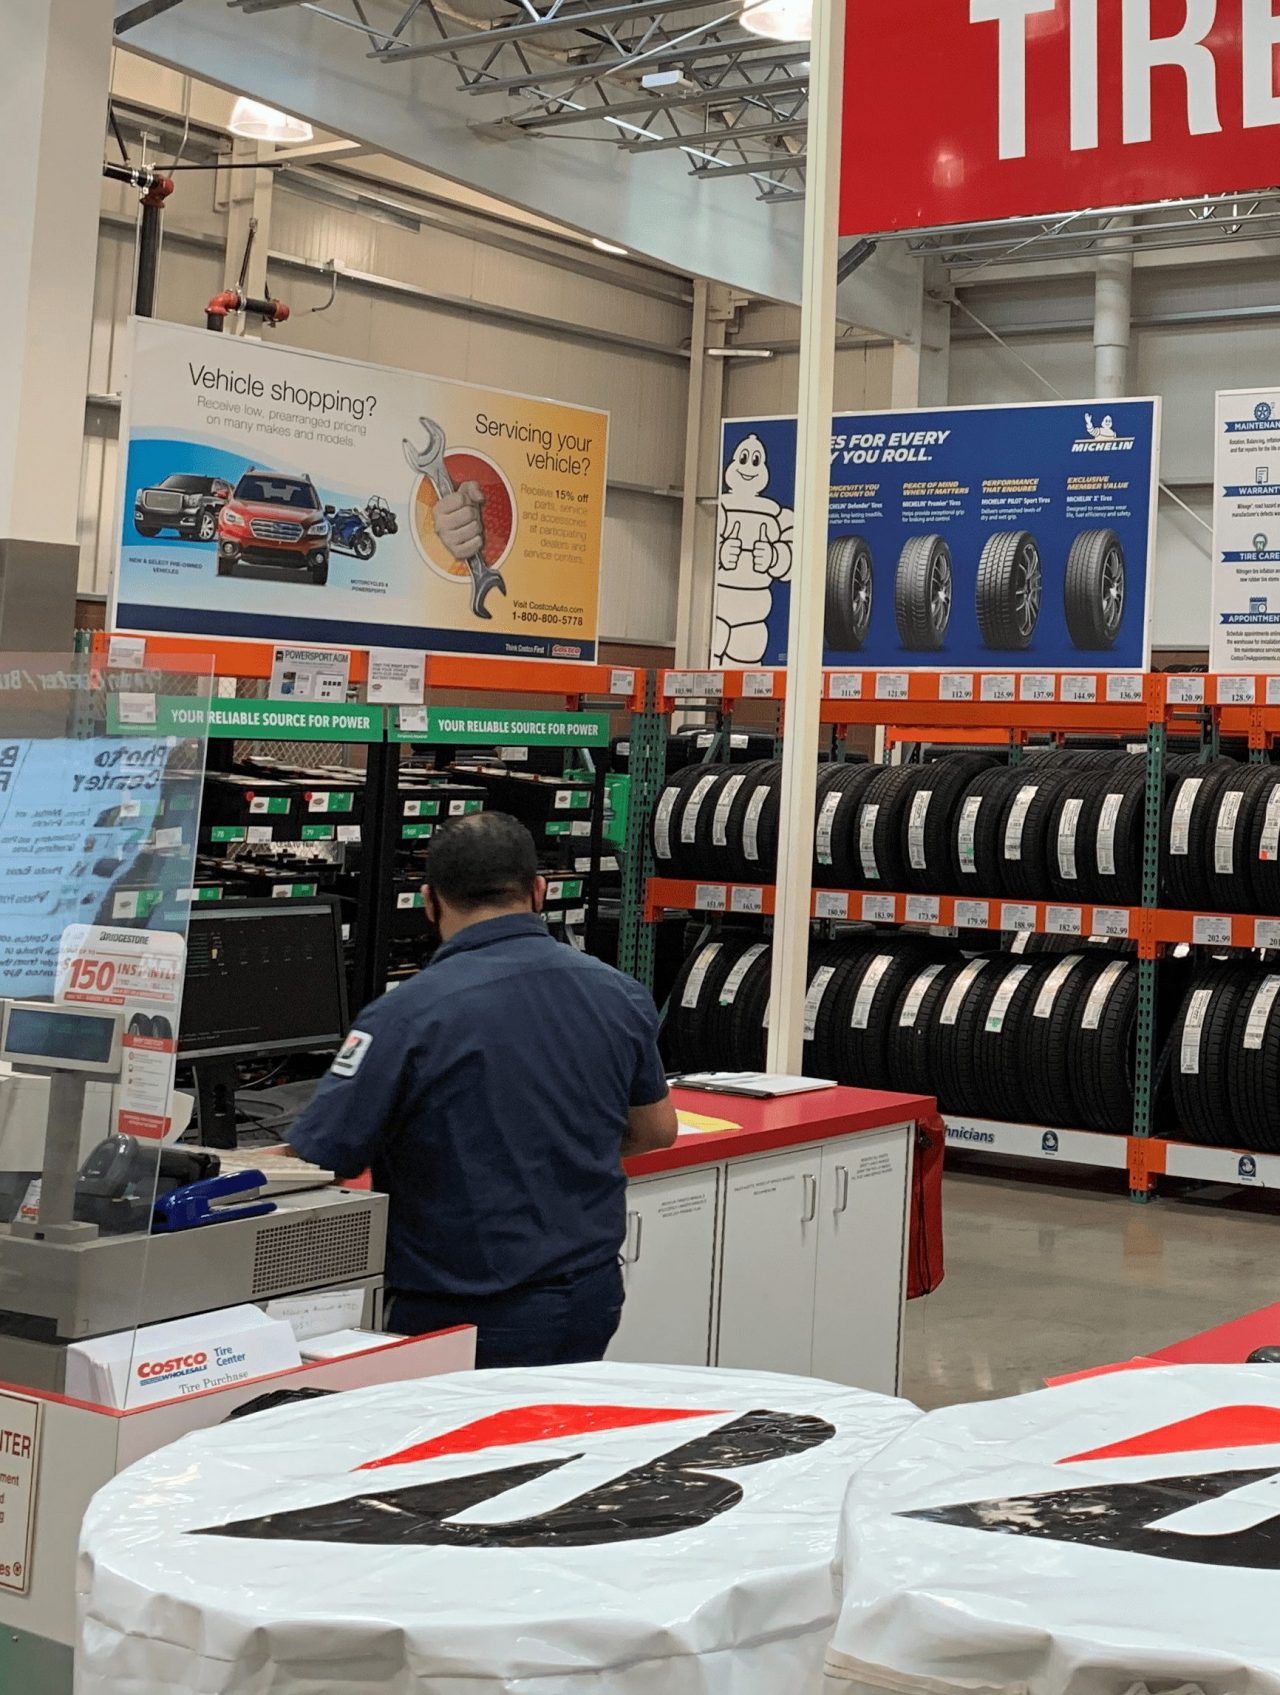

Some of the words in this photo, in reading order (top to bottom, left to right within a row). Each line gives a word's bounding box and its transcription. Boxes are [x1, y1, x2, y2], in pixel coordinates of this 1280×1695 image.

[189, 362, 264, 397] Vehicle
[271, 380, 377, 420] shopping?
[475, 413, 552, 449] Servicing
[558, 433, 592, 452] your
[848, 433, 886, 448] FOR
[888, 430, 951, 446] EVERY
[1072, 440, 1135, 453] MICHELIN
[843, 450, 880, 464] YOU
[881, 448, 933, 462] ROLL.
[526, 451, 591, 476] vehicle?
[1067, 475, 1110, 484] EXCLUSIVE
[1067, 483, 1103, 491] MEMBER
[555, 489, 575, 501] 15%
[577, 493, 589, 503] off
[1258, 552, 1280, 560] CARE
[513, 600, 528, 609] Visit
[529, 601, 584, 613] CostcoAuto.com
[512, 612, 583, 626] 1-800-800-5778
[285, 650, 332, 662] POWERSPORT
[171, 709, 204, 723] YOUR
[209, 711, 260, 726] RELIABLE
[263, 713, 306, 727] SOURCE
[309, 715, 329, 728] FOR
[332, 716, 370, 729] POWER
[438, 719, 465, 732] YOUR
[467, 720, 509, 733] RELIABLE
[511, 722, 546, 734] SOURCE
[548, 723, 566, 735] FOR
[567, 724, 598, 736] POWER
[1207, 934, 1231, 943] 202.99
[214, 1346, 233, 1357] Tire
[137, 1352, 208, 1378] COSTCO
[216, 1353, 246, 1366] Center
[162, 1365, 208, 1380] WHOLESALE
[179, 1383, 200, 1394] Tire
[203, 1370, 248, 1387] Purchase
